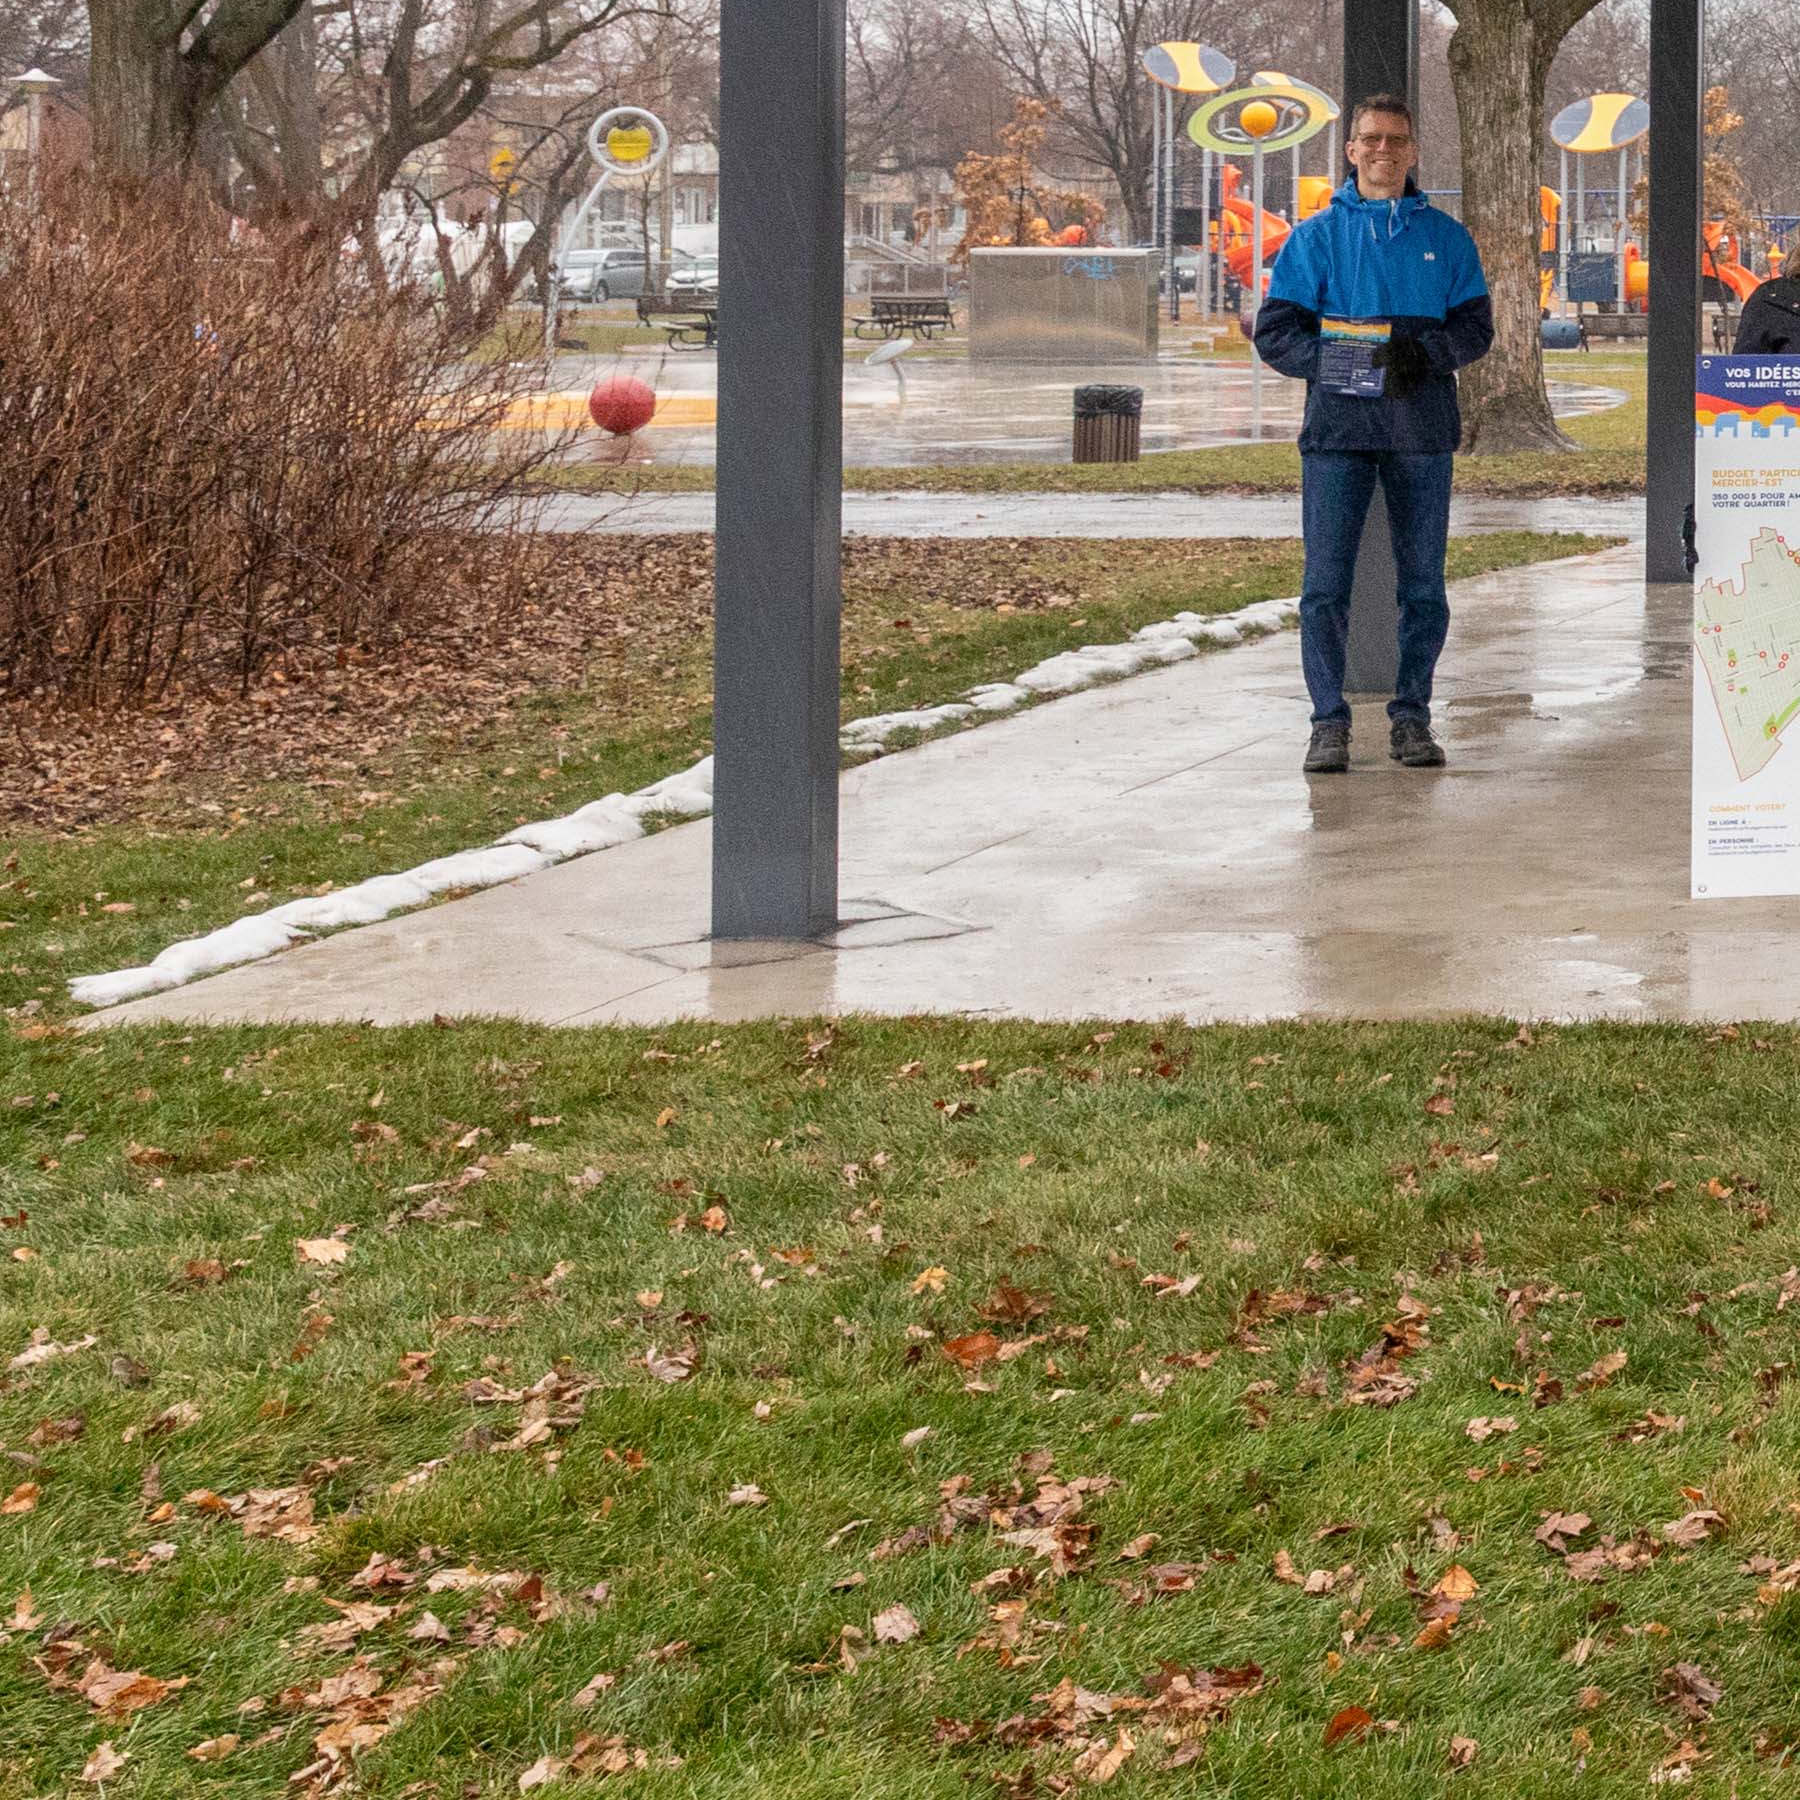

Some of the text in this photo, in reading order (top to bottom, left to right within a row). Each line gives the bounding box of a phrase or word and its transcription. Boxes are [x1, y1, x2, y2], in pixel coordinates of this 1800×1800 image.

[1725, 367, 1751, 378] VOS
[1712, 469, 1755, 478] BUDGET
[1712, 479, 1783, 487] MERCIER-EST
[1712, 493, 1729, 501] 350
[1760, 492, 1785, 500] POUR
[1712, 500, 1740, 508] VOTRE
